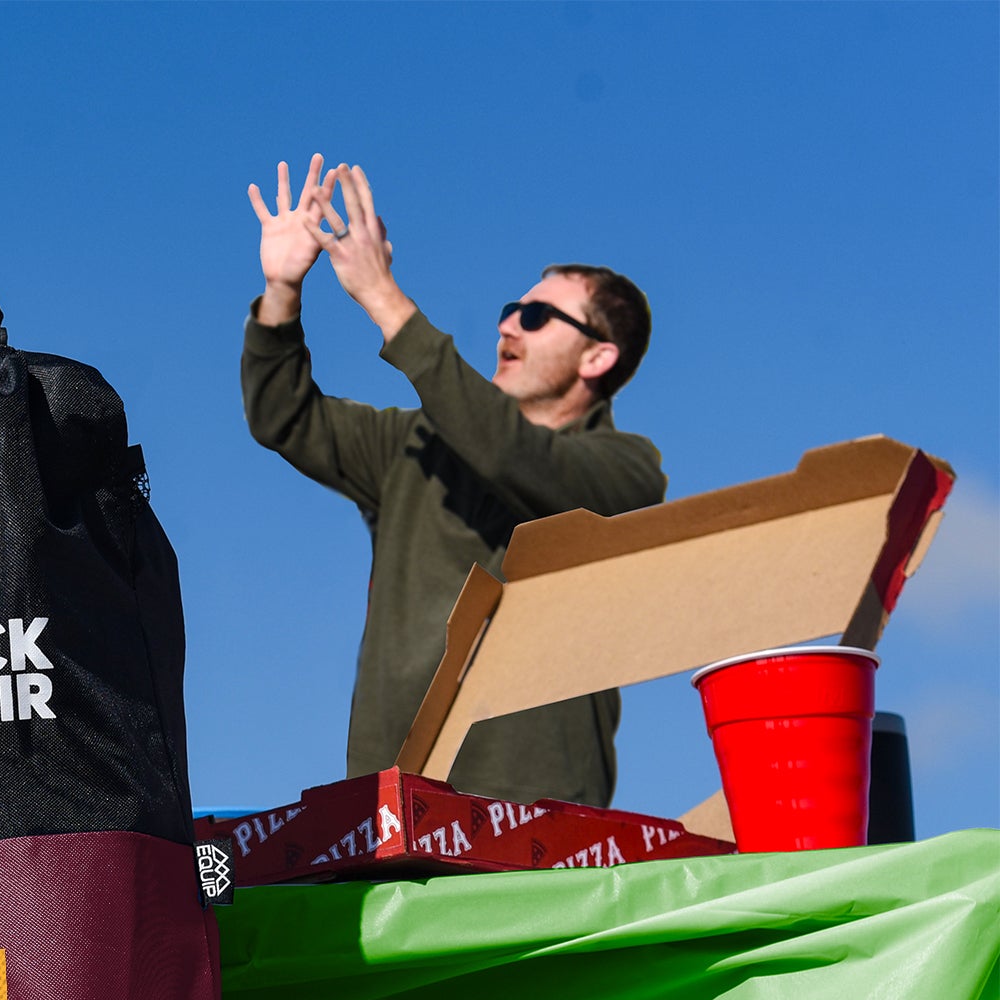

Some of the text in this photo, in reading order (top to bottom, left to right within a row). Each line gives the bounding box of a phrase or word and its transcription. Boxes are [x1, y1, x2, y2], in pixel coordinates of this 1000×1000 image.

[233, 805, 307, 857] PIZ
[310, 804, 400, 865] IZZA
[487, 802, 550, 837] PIZ
[196, 844, 217, 897] EQUIP
[552, 836, 626, 868] ZZA
